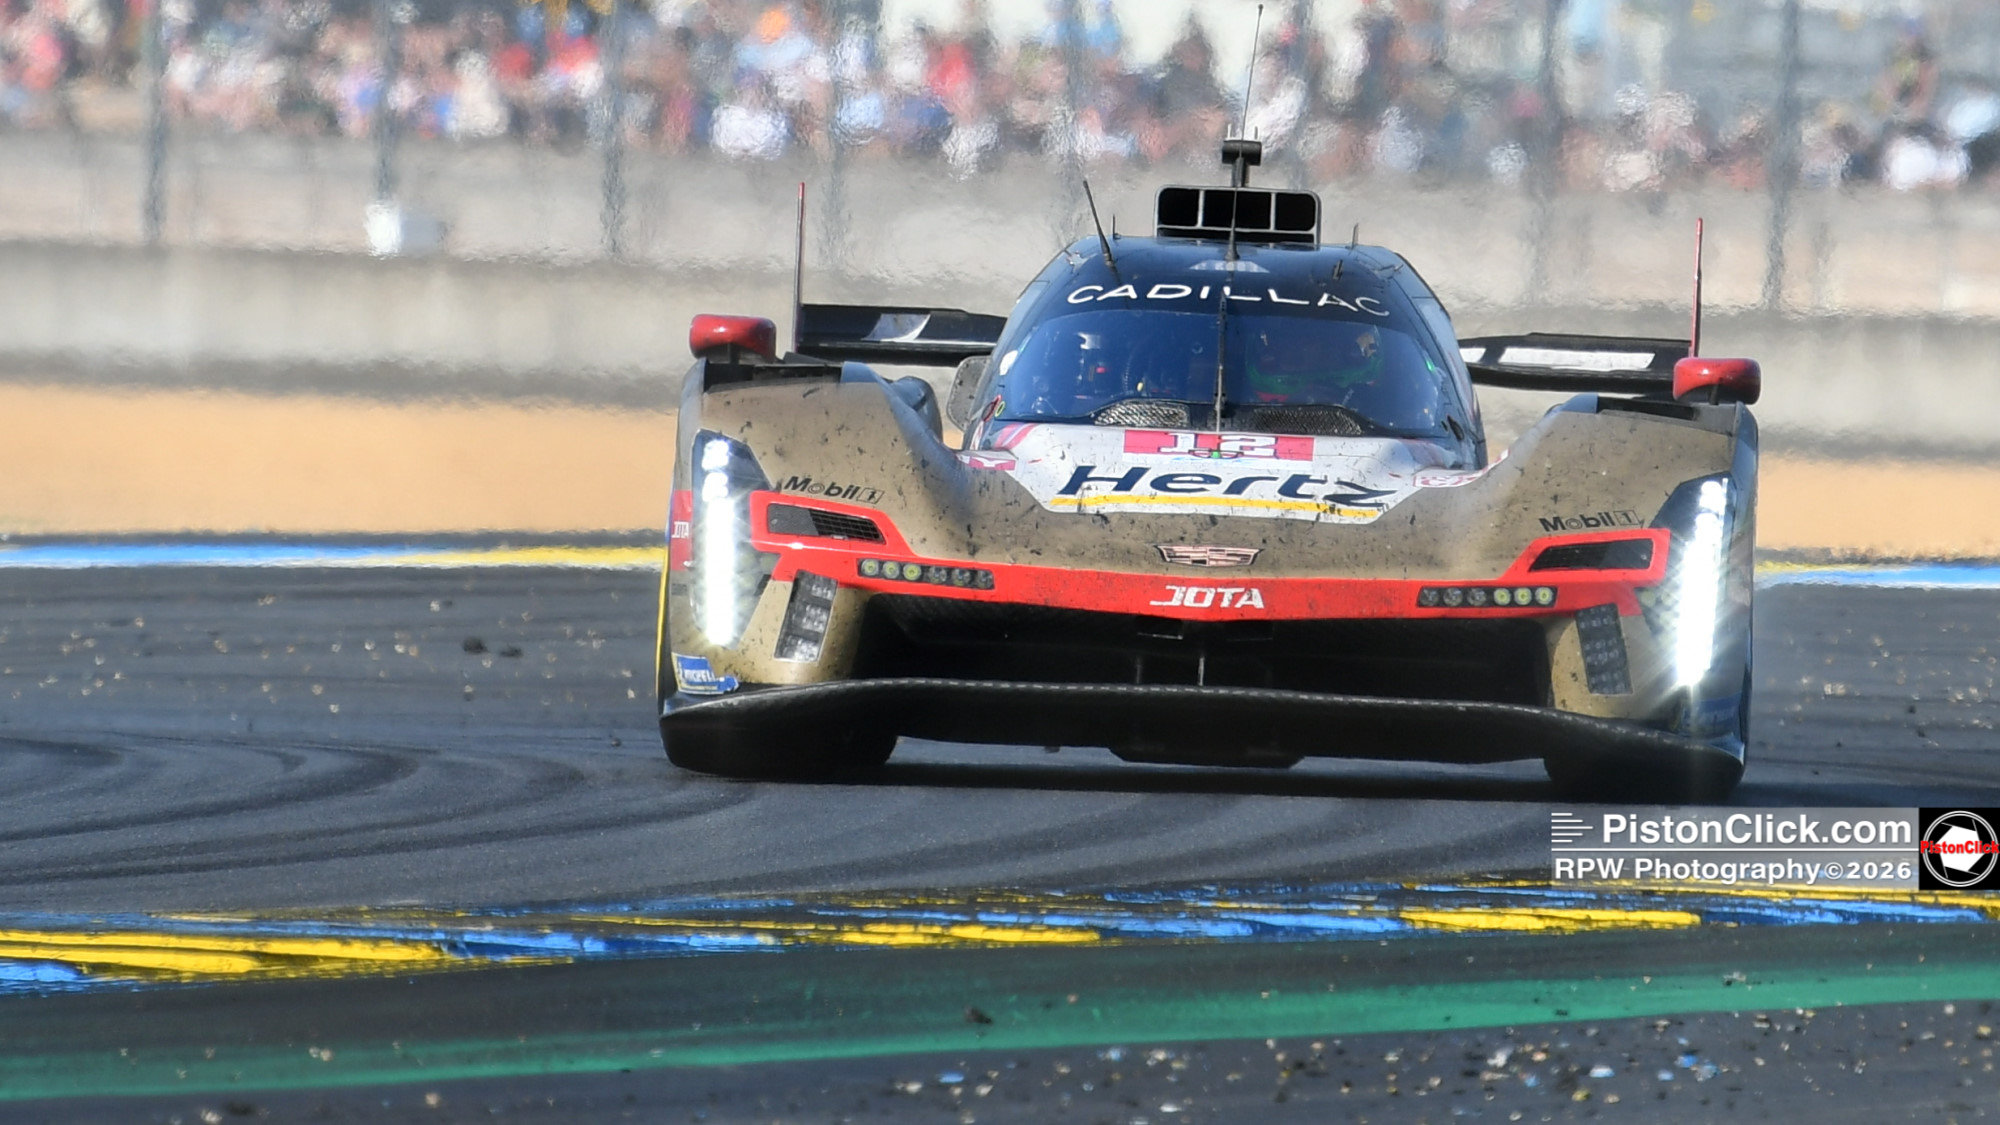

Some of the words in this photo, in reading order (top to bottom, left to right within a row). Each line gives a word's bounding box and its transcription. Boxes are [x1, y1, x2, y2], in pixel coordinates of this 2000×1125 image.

[1066, 284, 1391, 317] CADILLAC
[1158, 432, 1276, 458] 12
[784, 475, 861, 499] Mobil
[1059, 465, 1397, 510] Hertz
[1539, 512, 1615, 532] Mobil
[1150, 586, 1265, 608] JOTA
